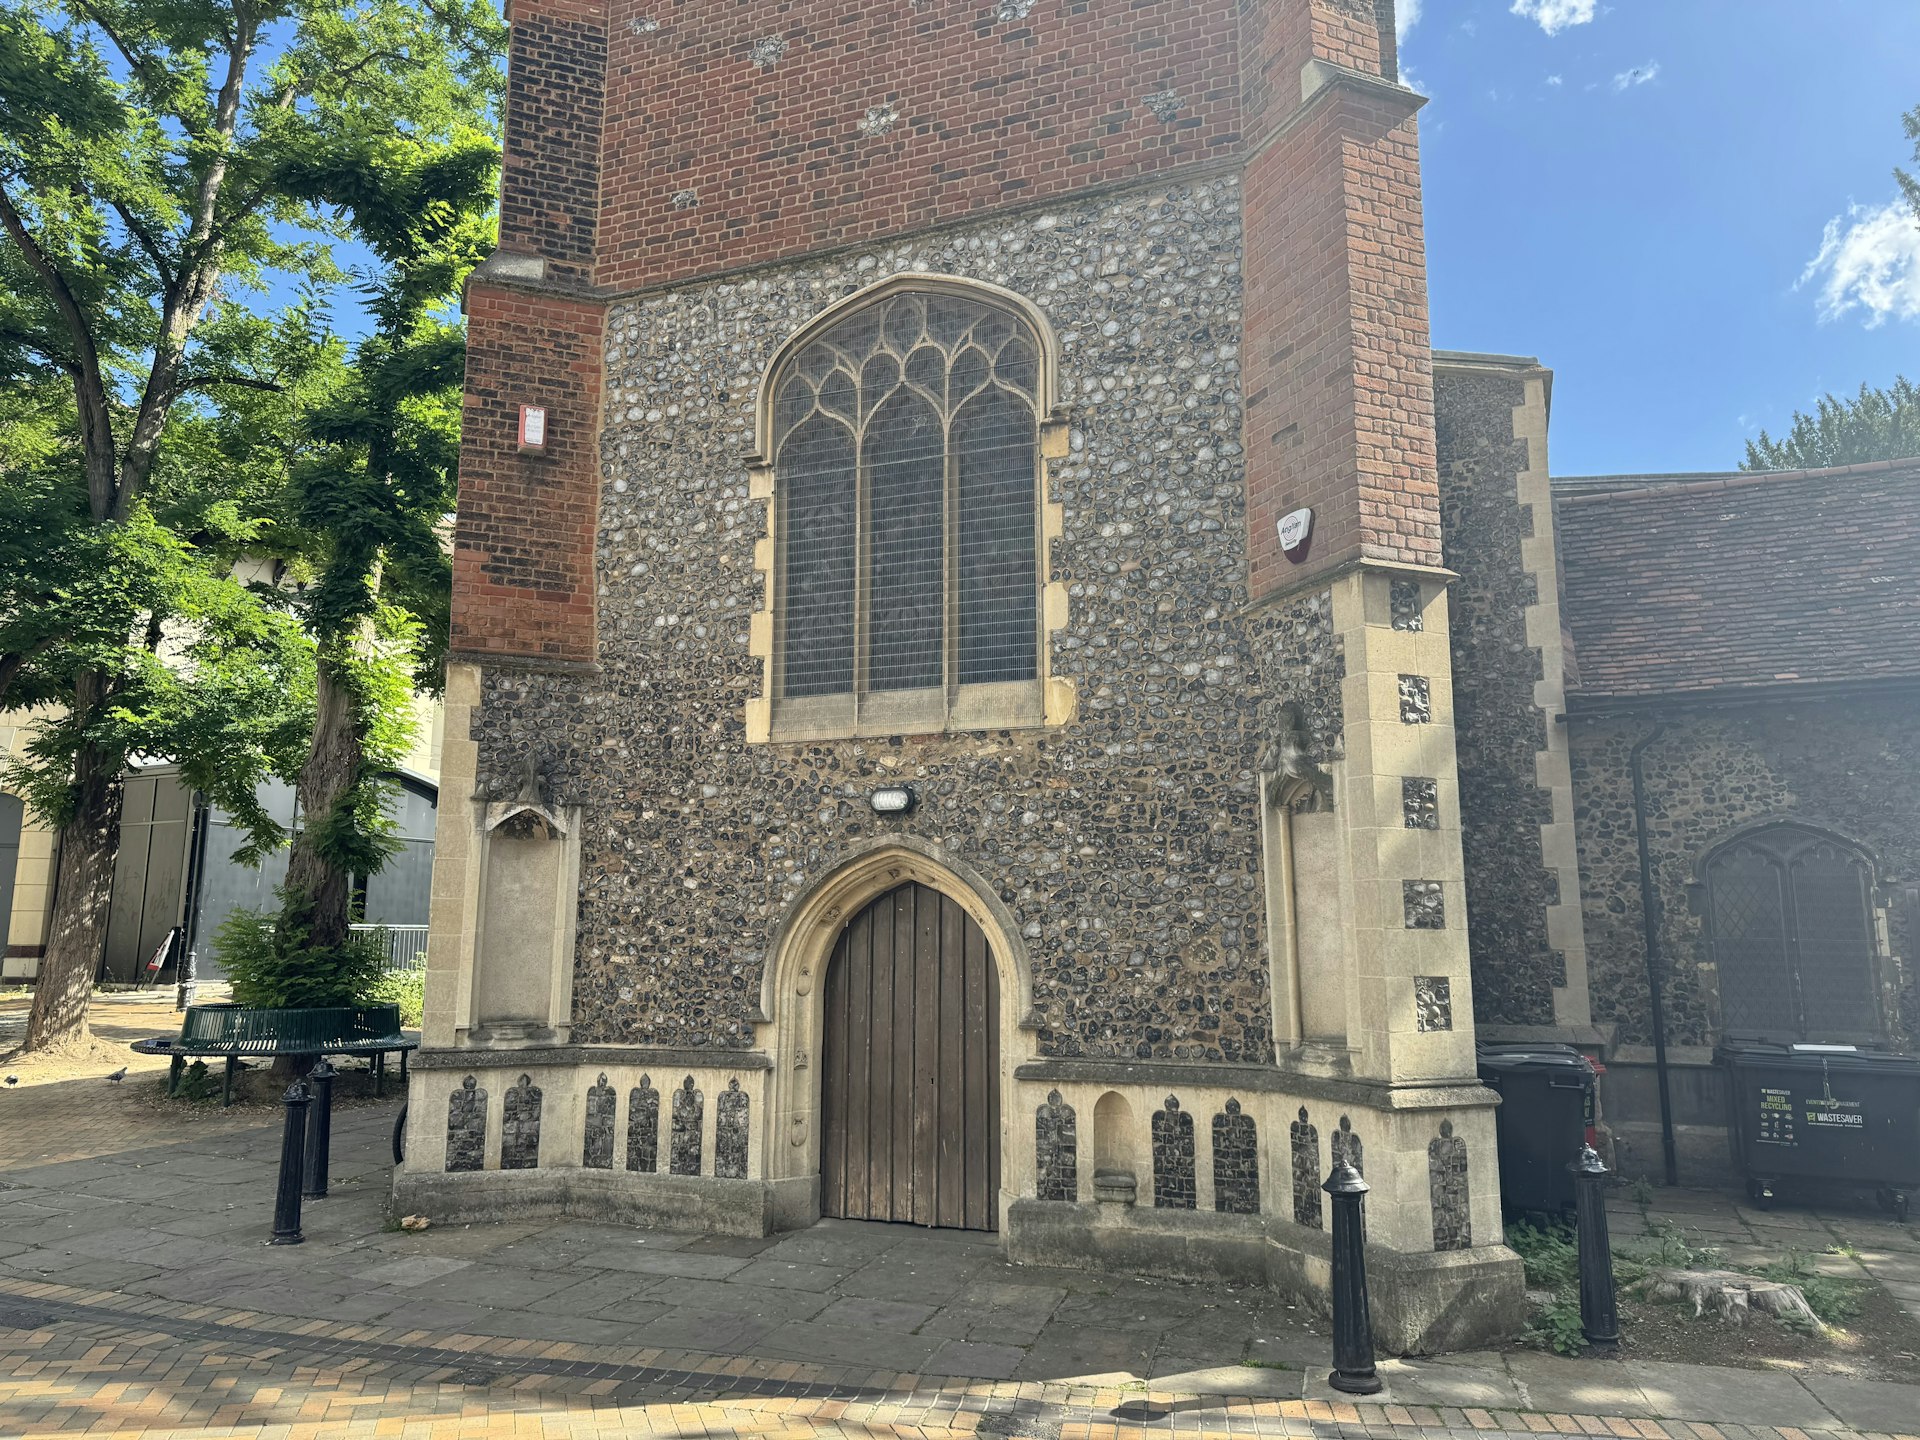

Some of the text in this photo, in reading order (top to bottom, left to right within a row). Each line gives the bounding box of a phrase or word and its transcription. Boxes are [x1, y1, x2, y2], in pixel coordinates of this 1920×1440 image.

[1766, 1095, 1785, 1103] MIXED
[1760, 1102, 1792, 1111] RECYCLING
[1816, 1112, 1863, 1124] WASTESAVER
